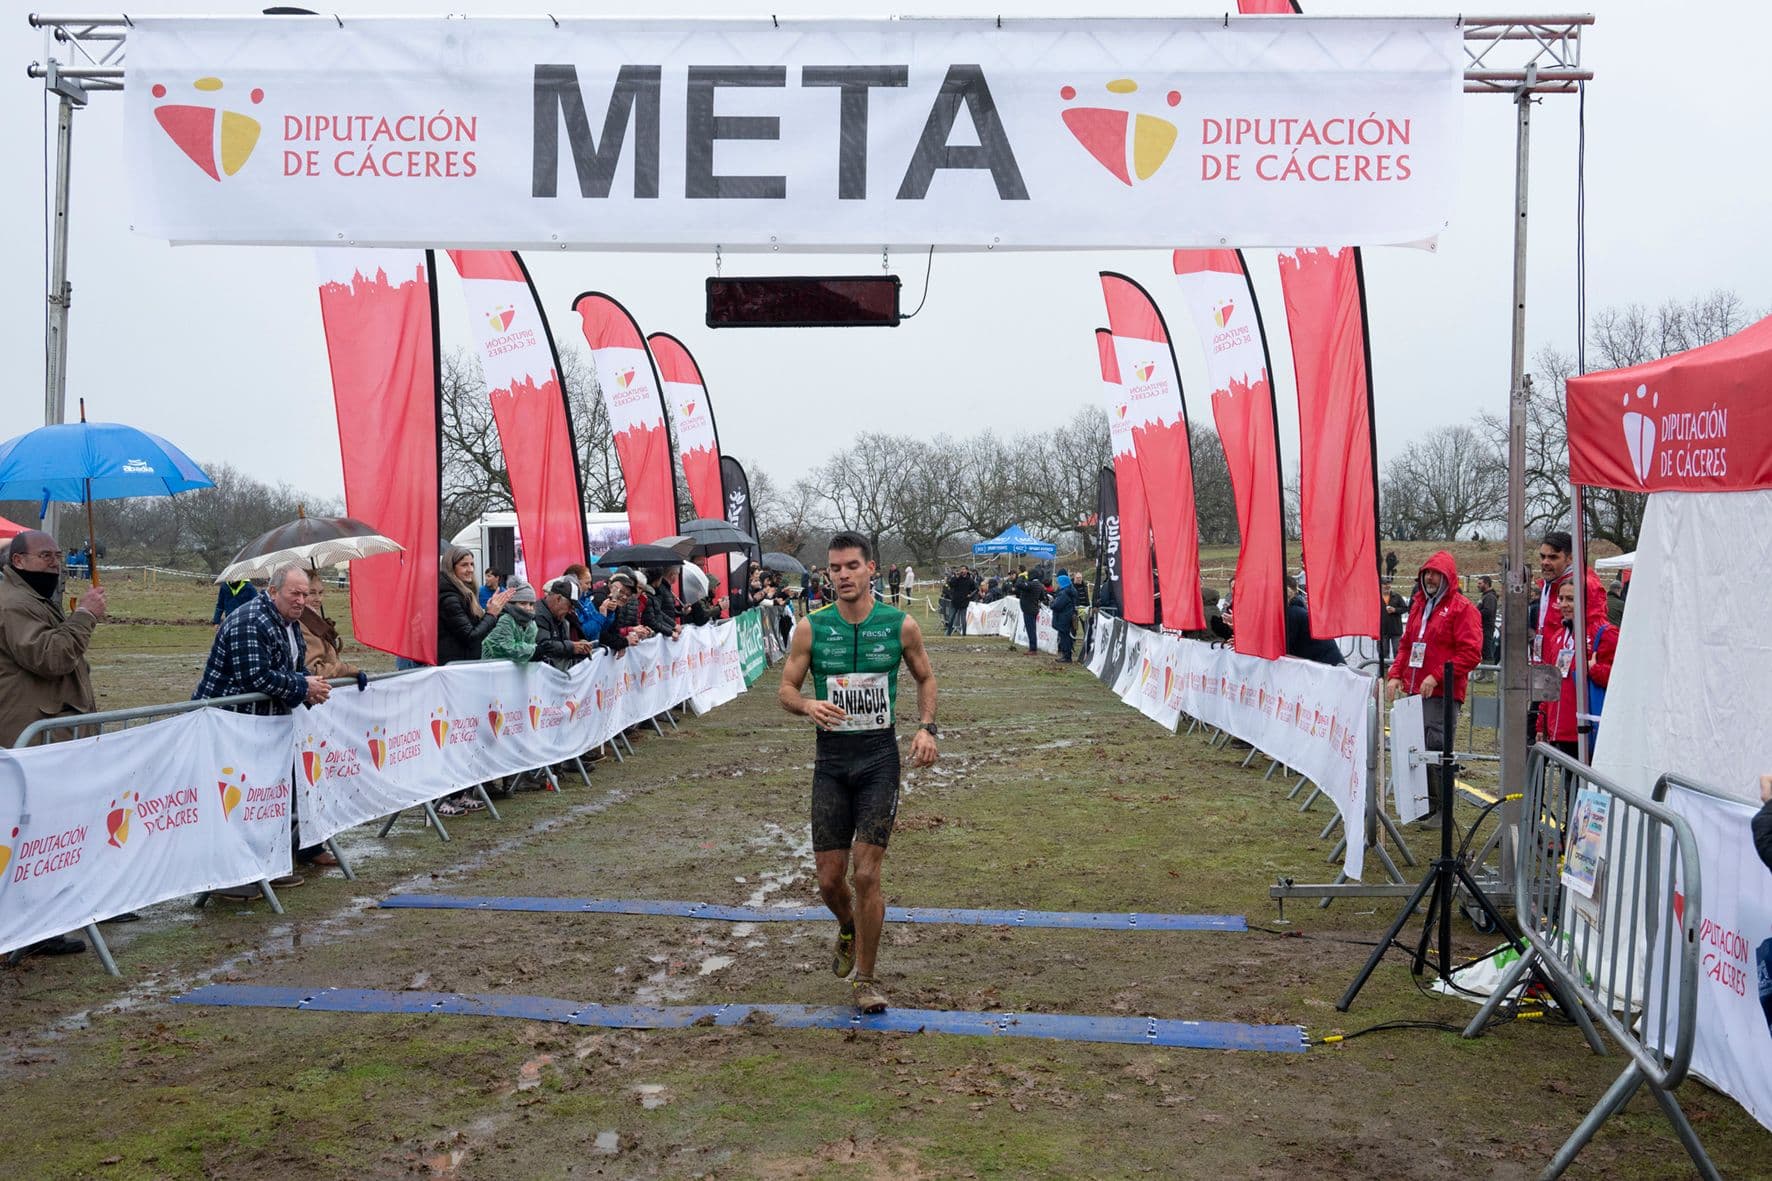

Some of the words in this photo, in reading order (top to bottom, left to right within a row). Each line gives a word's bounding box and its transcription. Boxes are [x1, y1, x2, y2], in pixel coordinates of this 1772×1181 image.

[283, 109, 478, 142] DIPUTACIÓN
[532, 64, 1030, 200] META
[1201, 111, 1412, 146] DIPUTACIÓN
[283, 151, 323, 177] DE
[334, 146, 478, 177] CÁCERES
[1201, 154, 1242, 181] DE
[1256, 147, 1412, 182] CÁCERES
[1661, 402, 1728, 442] DIPUTACIÓN
[1660, 451, 1673, 478] DE
[1676, 443, 1727, 478] CÁCERES
[832, 687, 888, 715] PANIAGUA
[875, 714, 885, 725] 6
[243, 806, 255, 821] DE
[19, 823, 89, 860] DIPUTACIÓN
[14, 862, 31, 883] DE
[33, 847, 82, 877] CÁCERES
